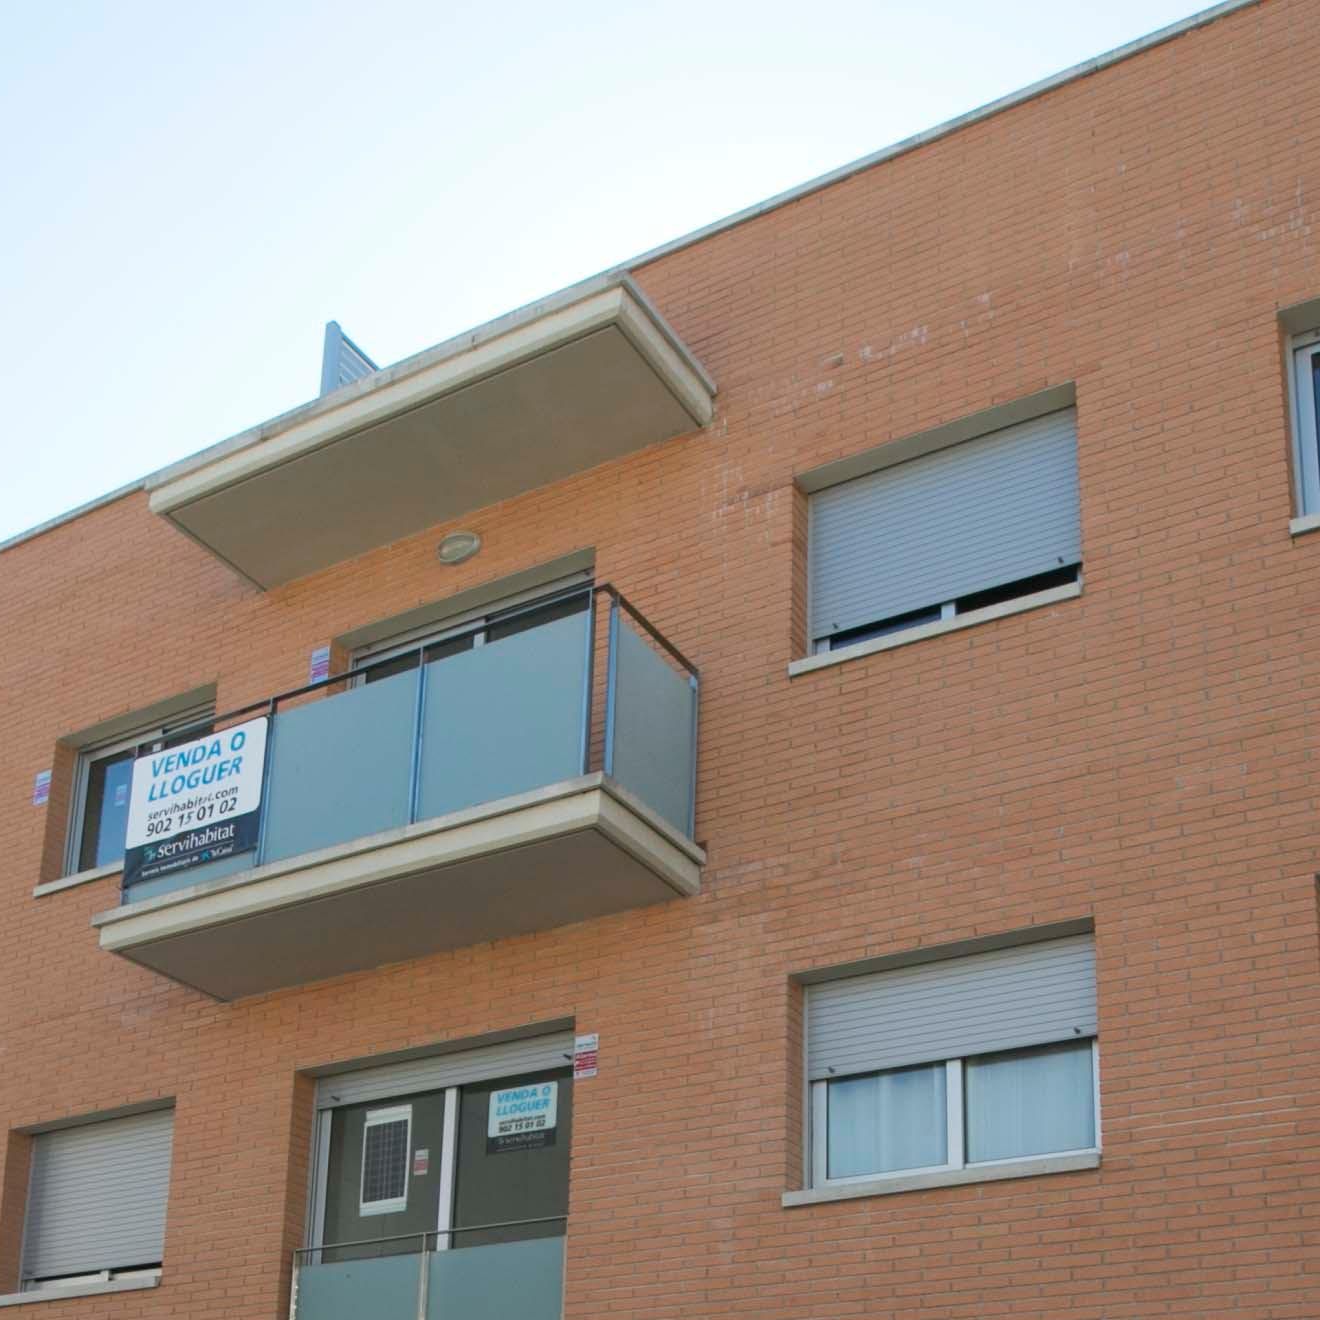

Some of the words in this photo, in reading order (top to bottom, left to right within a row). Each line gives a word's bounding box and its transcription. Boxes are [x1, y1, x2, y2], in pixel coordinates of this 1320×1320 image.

[151, 739, 222, 778] VENDA
[230, 731, 247, 751] O
[148, 756, 243, 802] LLOGUER
[145, 817, 173, 837] 902
[178, 811, 196, 829] 15
[197, 804, 215, 821] 01
[219, 797, 238, 814] 02
[496, 1099, 550, 1115] LLOGUER
[497, 1089, 537, 1103] VENDA
[542, 1087, 551, 1096] O
